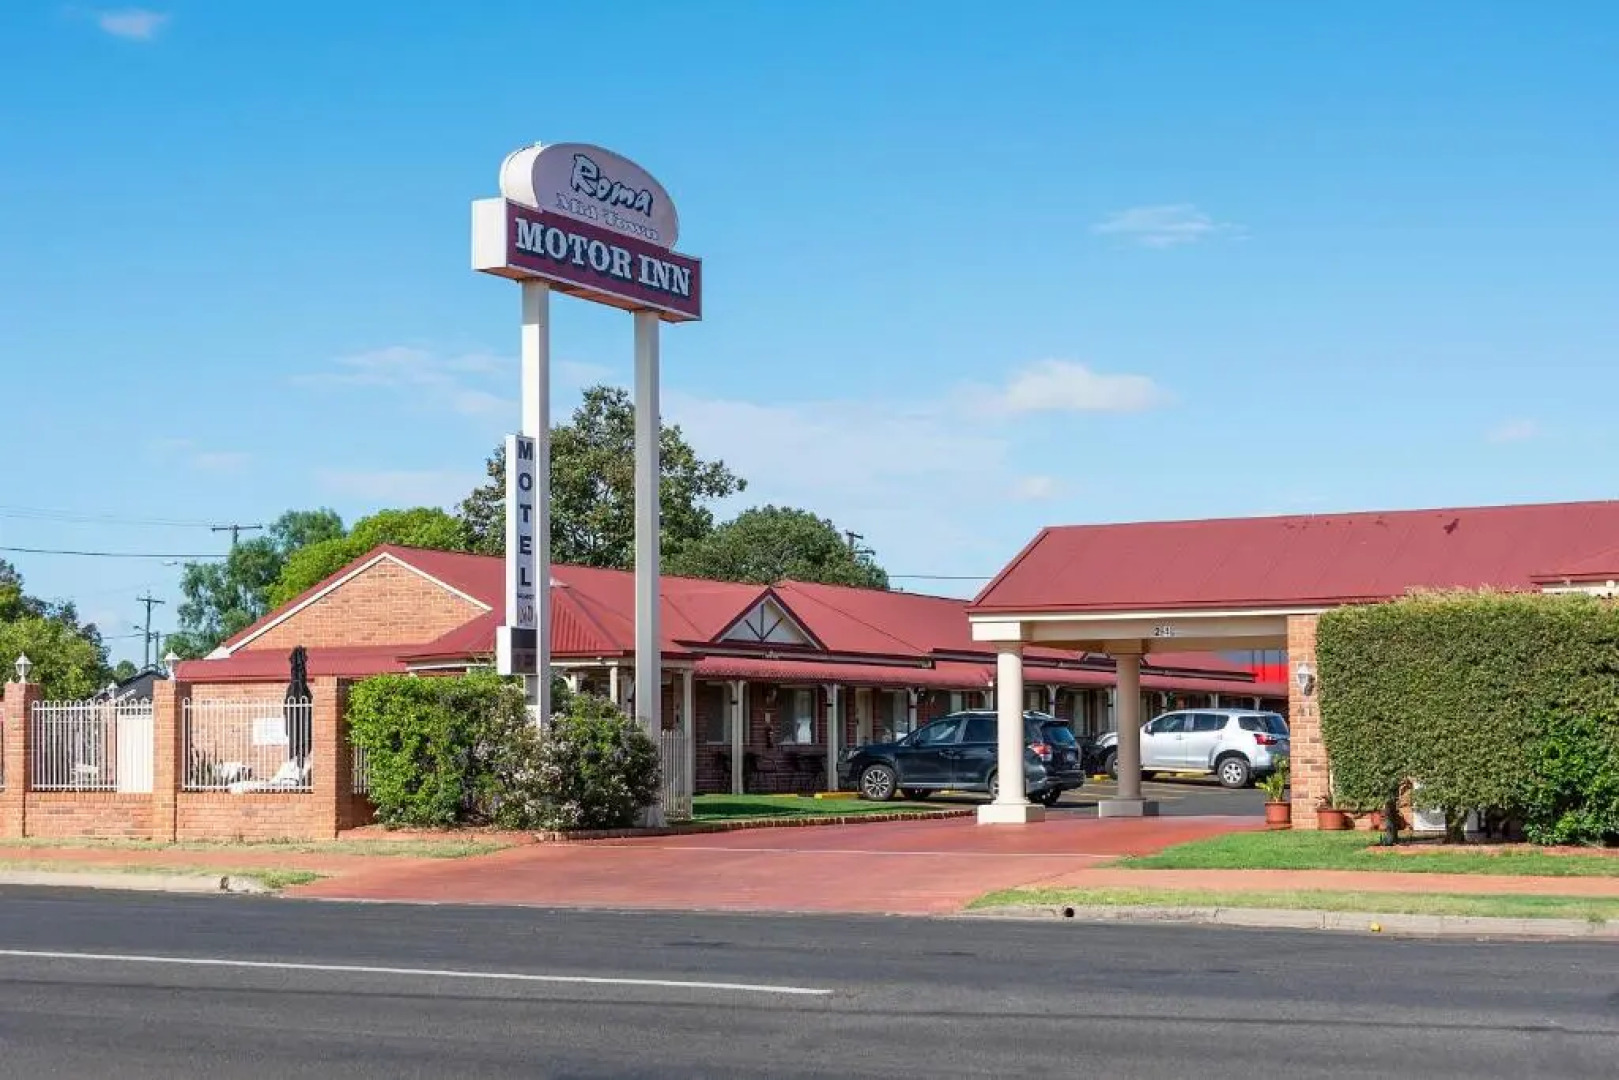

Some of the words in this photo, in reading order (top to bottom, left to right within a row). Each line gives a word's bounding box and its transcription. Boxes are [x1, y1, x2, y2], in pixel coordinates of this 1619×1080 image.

[515, 217, 632, 280] MOTOR
[638, 254, 691, 297] INN
[518, 440, 533, 587] MOTEL
